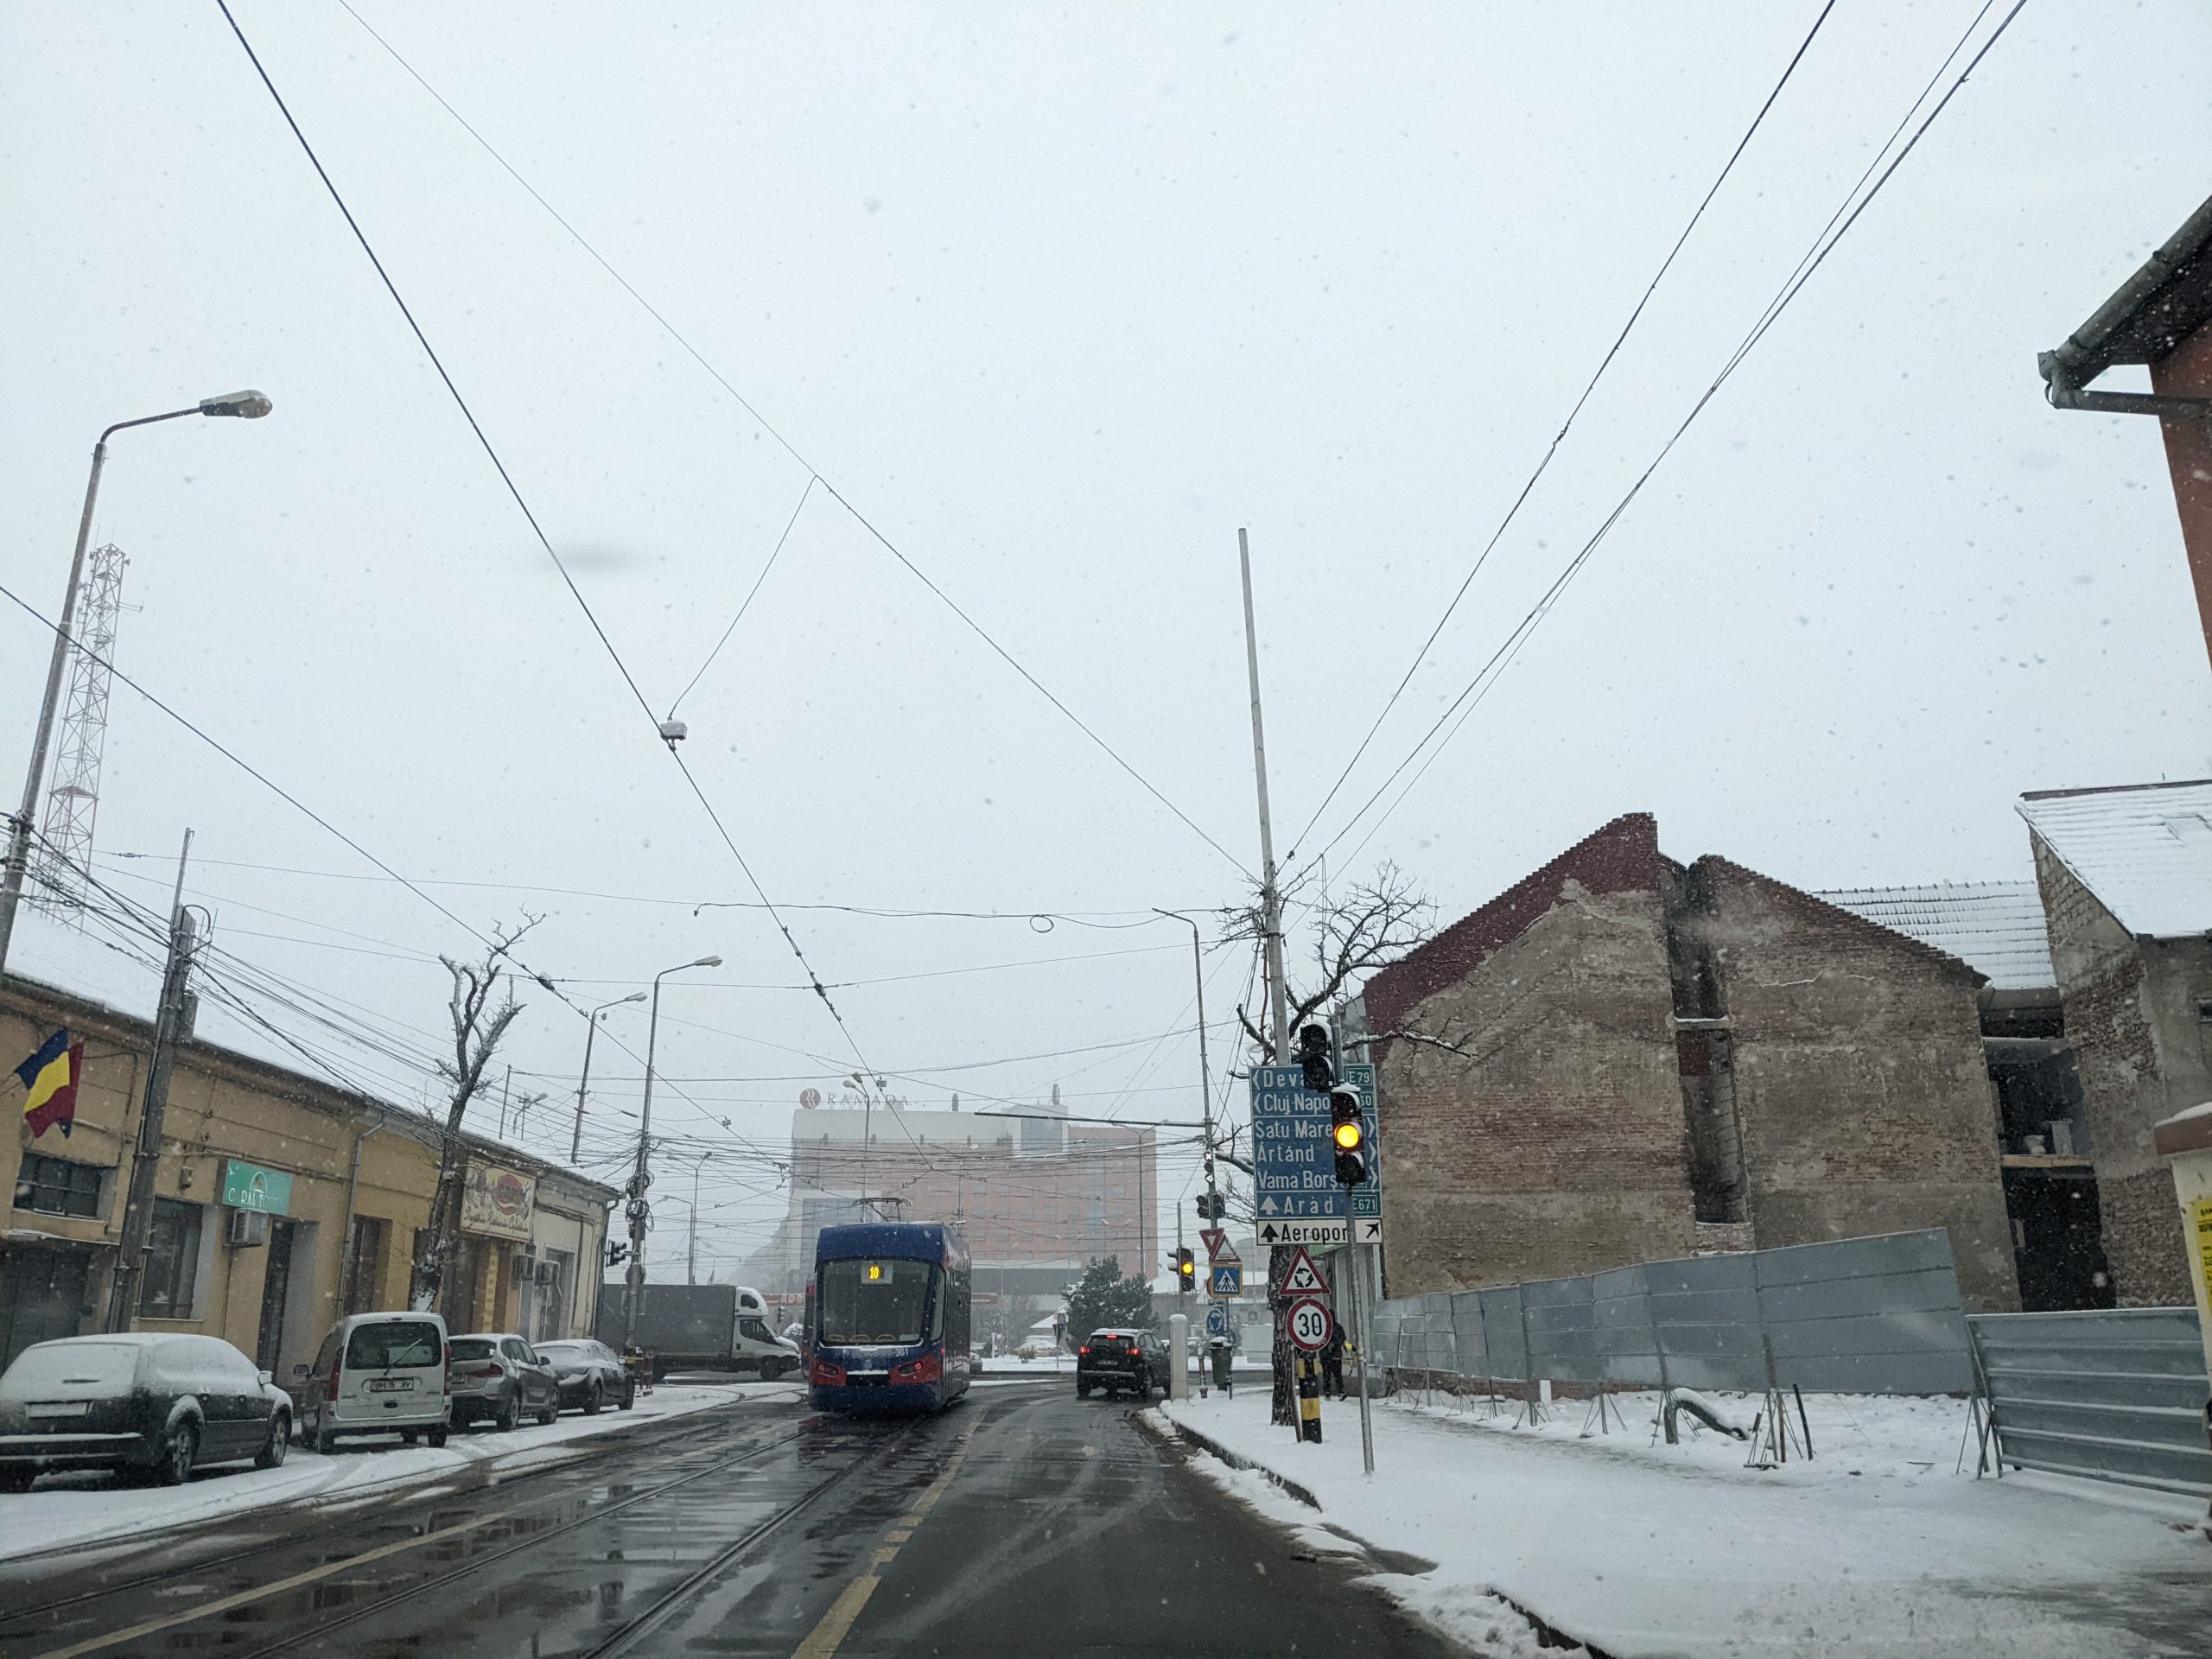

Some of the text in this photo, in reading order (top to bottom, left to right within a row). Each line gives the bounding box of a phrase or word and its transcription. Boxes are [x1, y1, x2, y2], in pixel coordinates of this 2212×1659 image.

[1348, 1071, 1370, 1083] E79
[828, 1093, 909, 1106] RAMADA
[1255, 1120, 1333, 1139] Satu Mare
[1257, 1171, 1299, 1189] Vama
[1283, 1195, 1333, 1215] Arad
[1281, 1223, 1347, 1244] Aeropor
[869, 1266, 880, 1279] 10
[1298, 1313, 1323, 1337] 30
